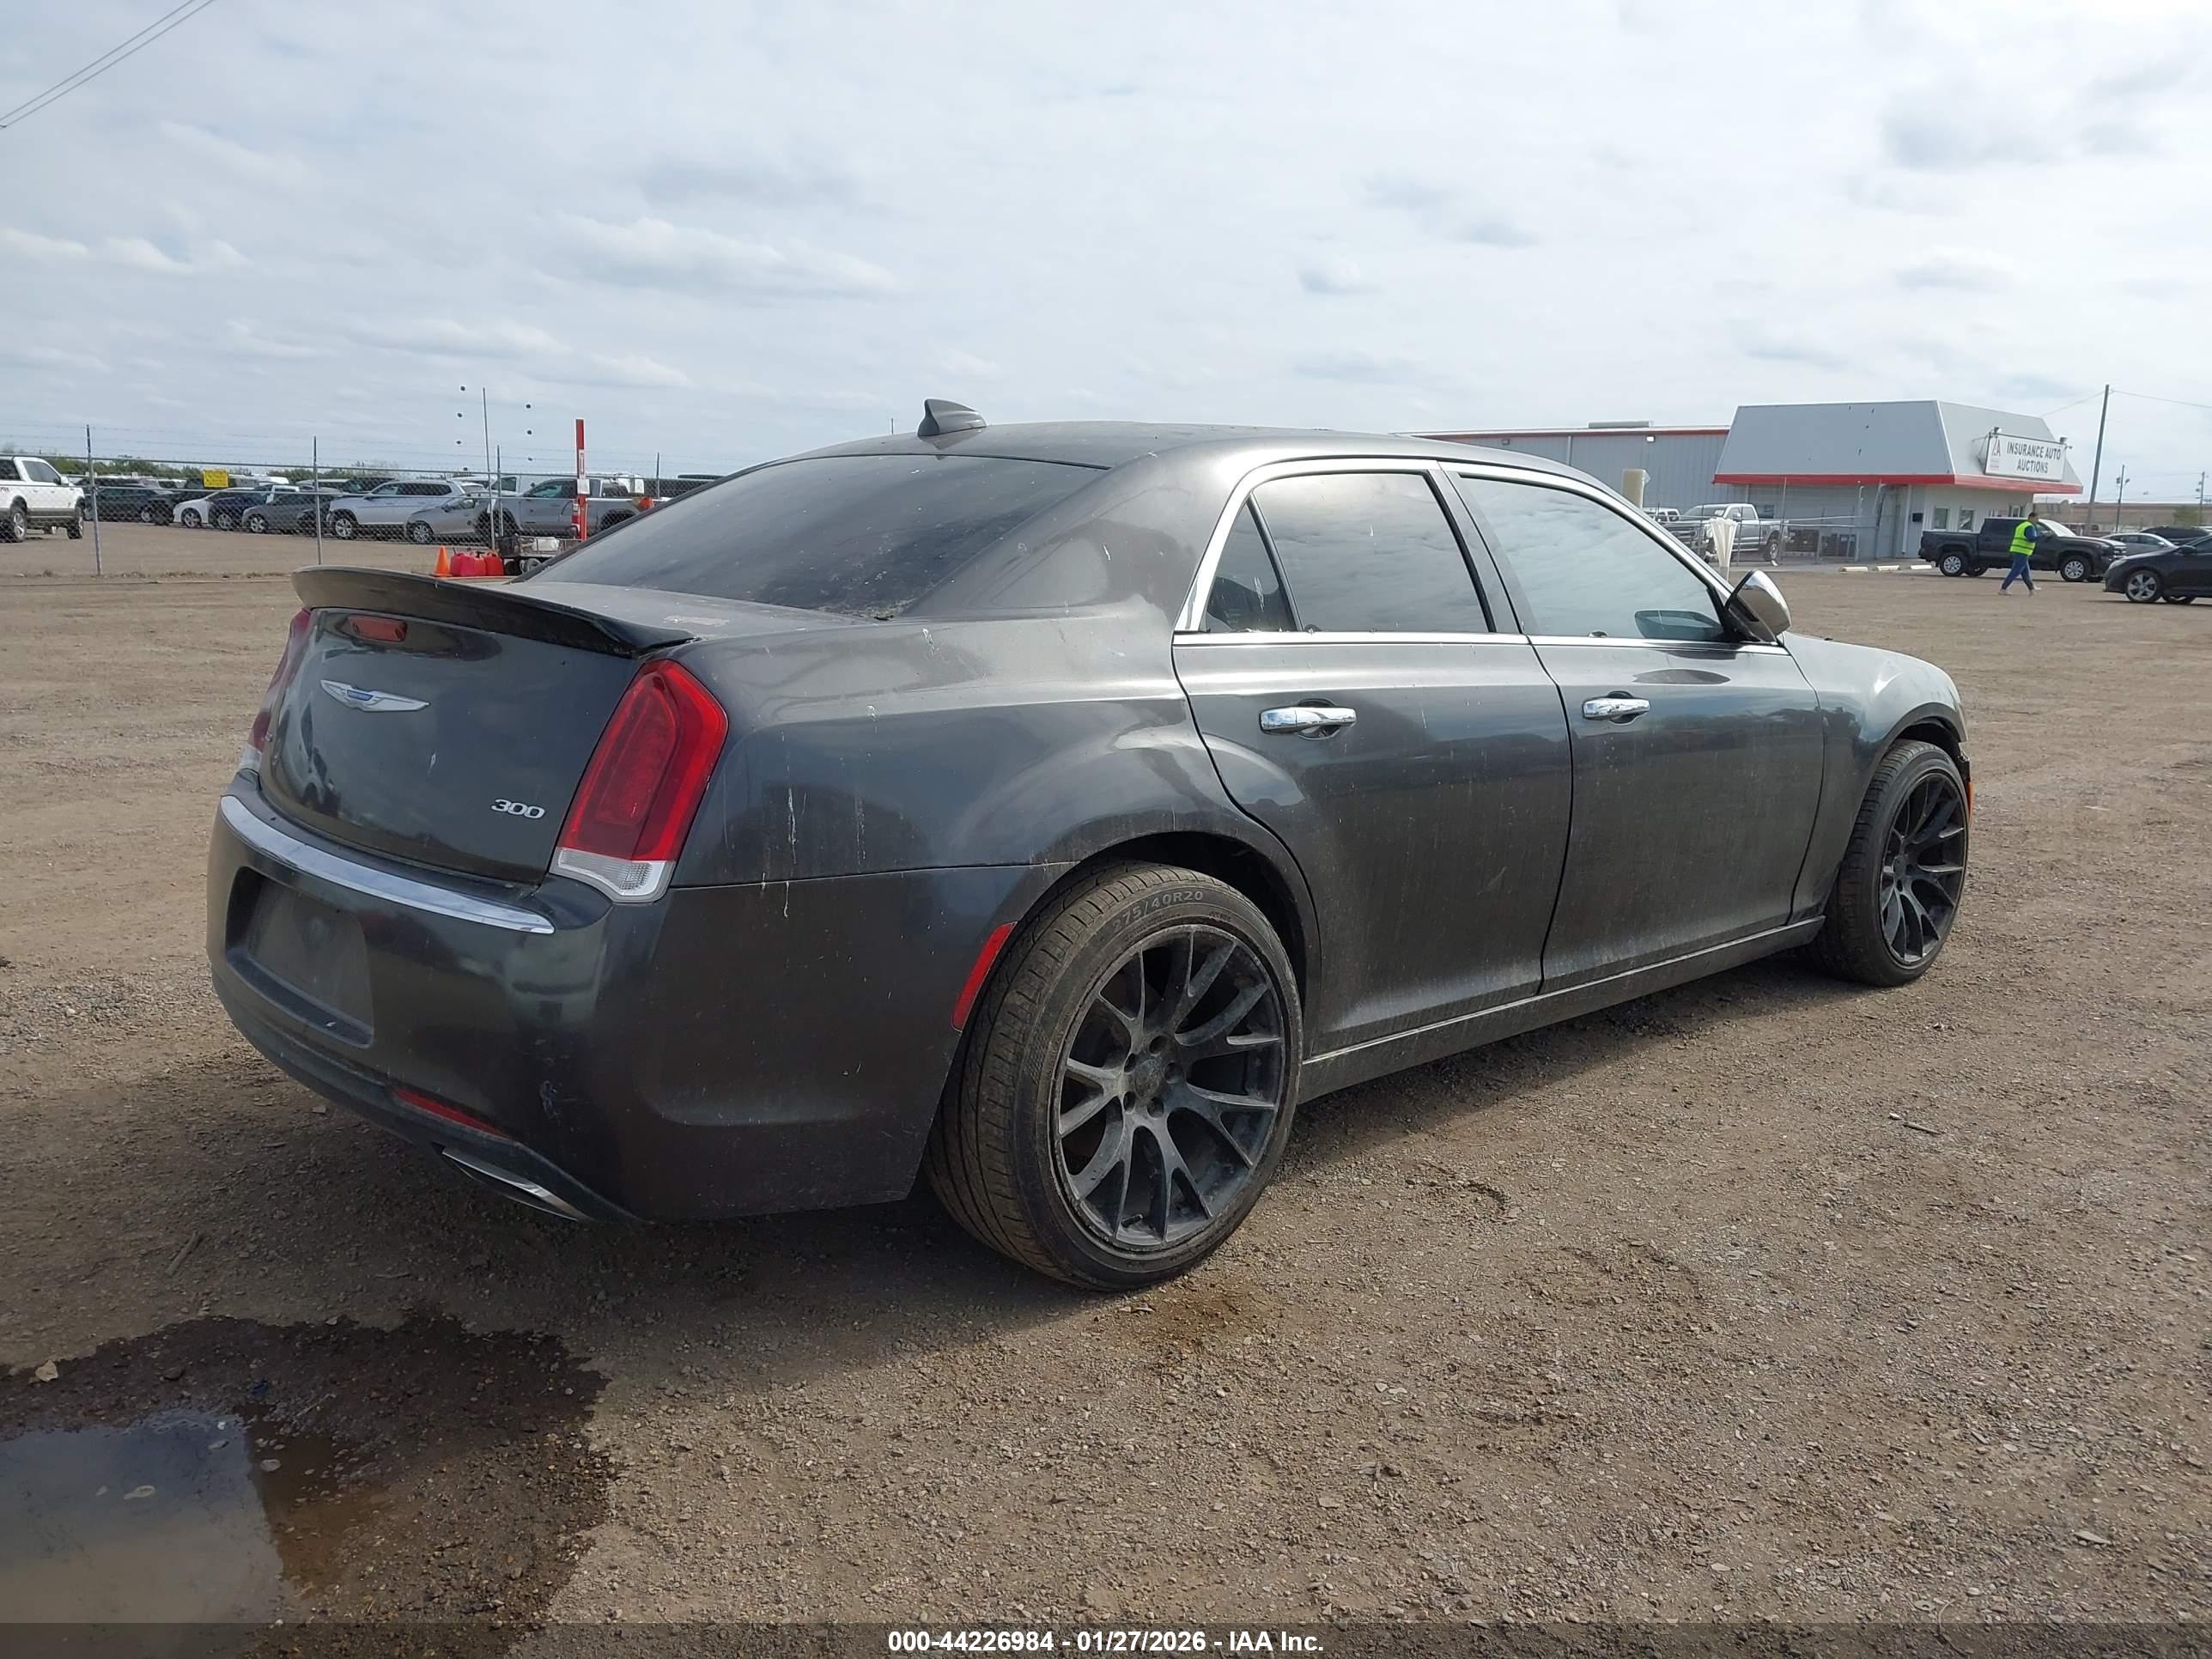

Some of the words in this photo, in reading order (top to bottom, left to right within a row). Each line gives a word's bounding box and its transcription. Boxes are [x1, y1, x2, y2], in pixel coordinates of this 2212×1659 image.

[2006, 441, 2045, 459] INSURANCE
[2044, 447, 2061, 460] AUTO
[2016, 458, 2049, 474] AUCTIONS
[490, 799, 545, 819] 300
